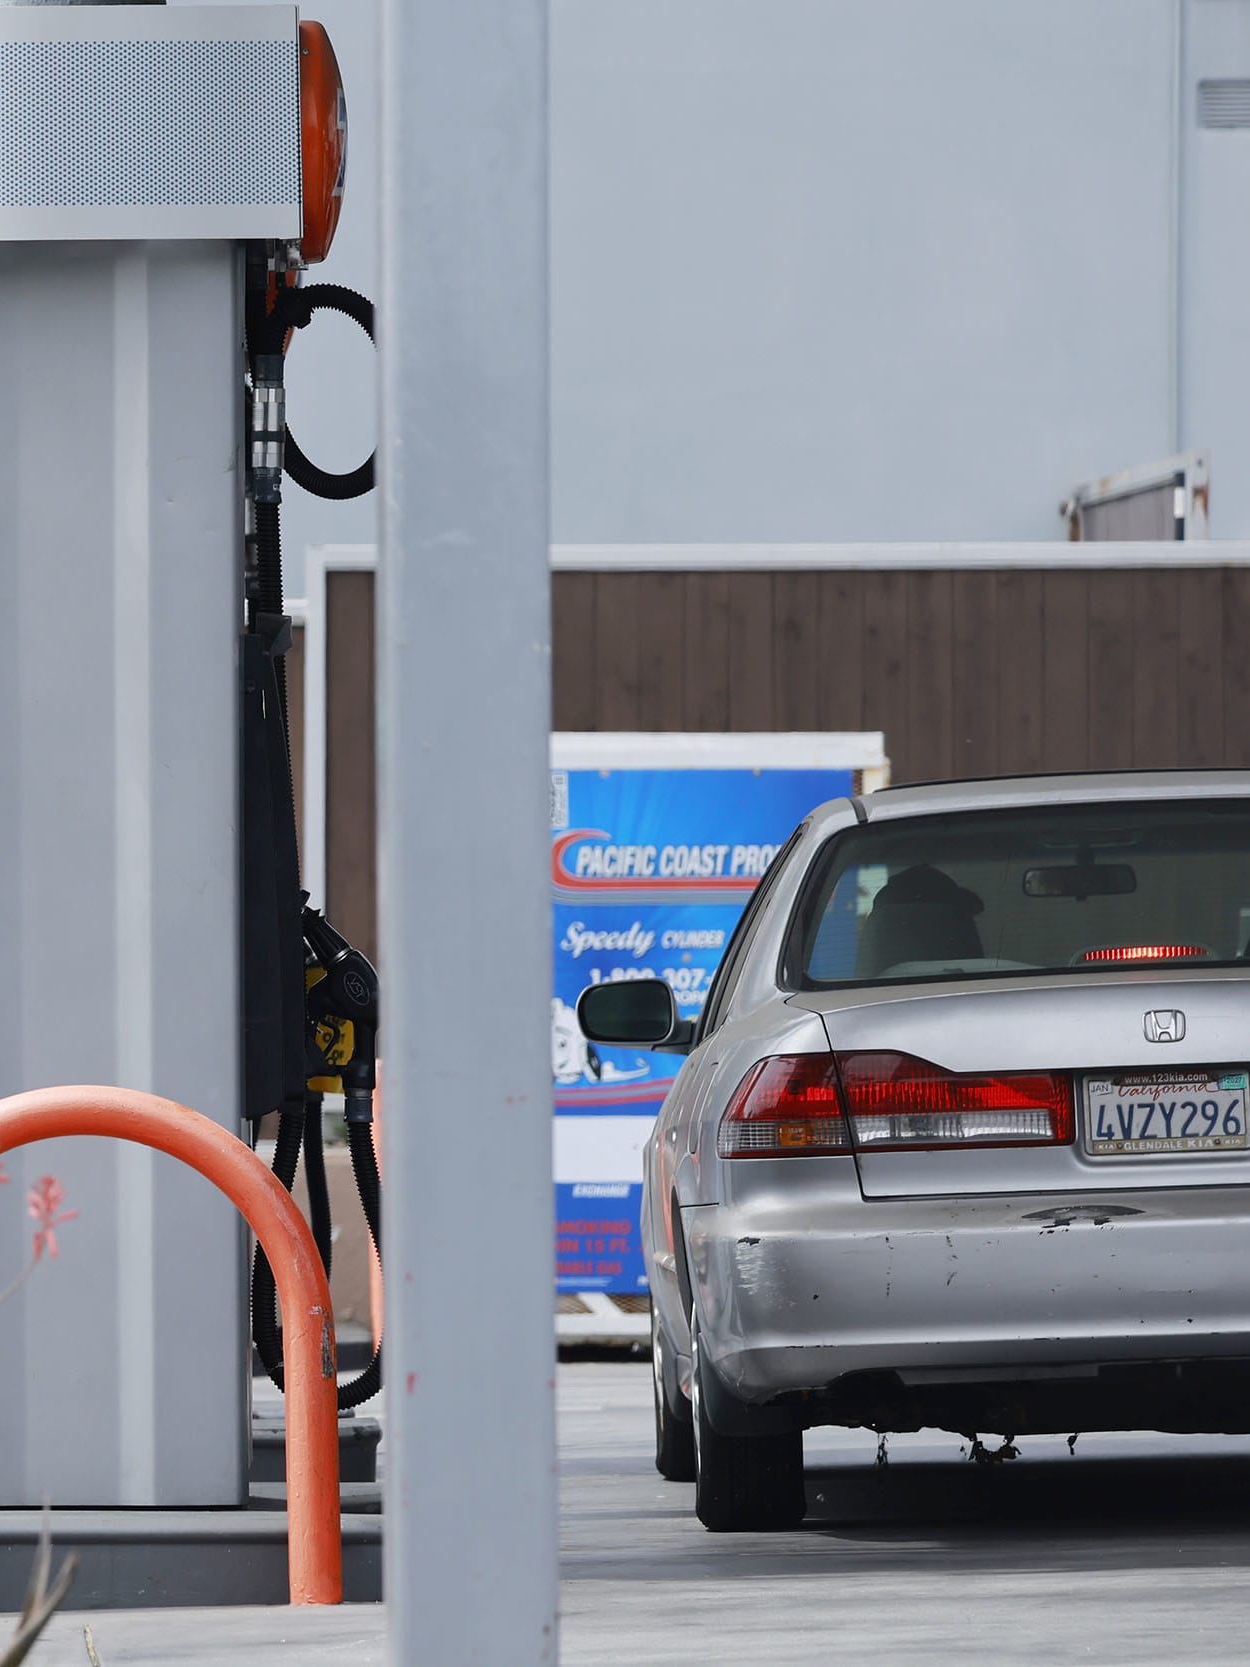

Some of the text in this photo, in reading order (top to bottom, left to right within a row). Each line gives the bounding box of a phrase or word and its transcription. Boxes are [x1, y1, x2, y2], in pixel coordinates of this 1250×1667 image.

[575, 845, 656, 877] PACIFIC
[659, 845, 729, 877] COAST
[561, 920, 725, 959] Speedy CYLINDER
[1124, 1072, 1208, 1084] www.123kia.com
[1090, 1084, 1109, 1093] JAN
[1117, 1083, 1219, 1101] California
[1096, 1099, 1241, 1140] 4VZY296
[1124, 1140, 1183, 1151] GLENDALE
[1187, 1138, 1214, 1147] KIA
